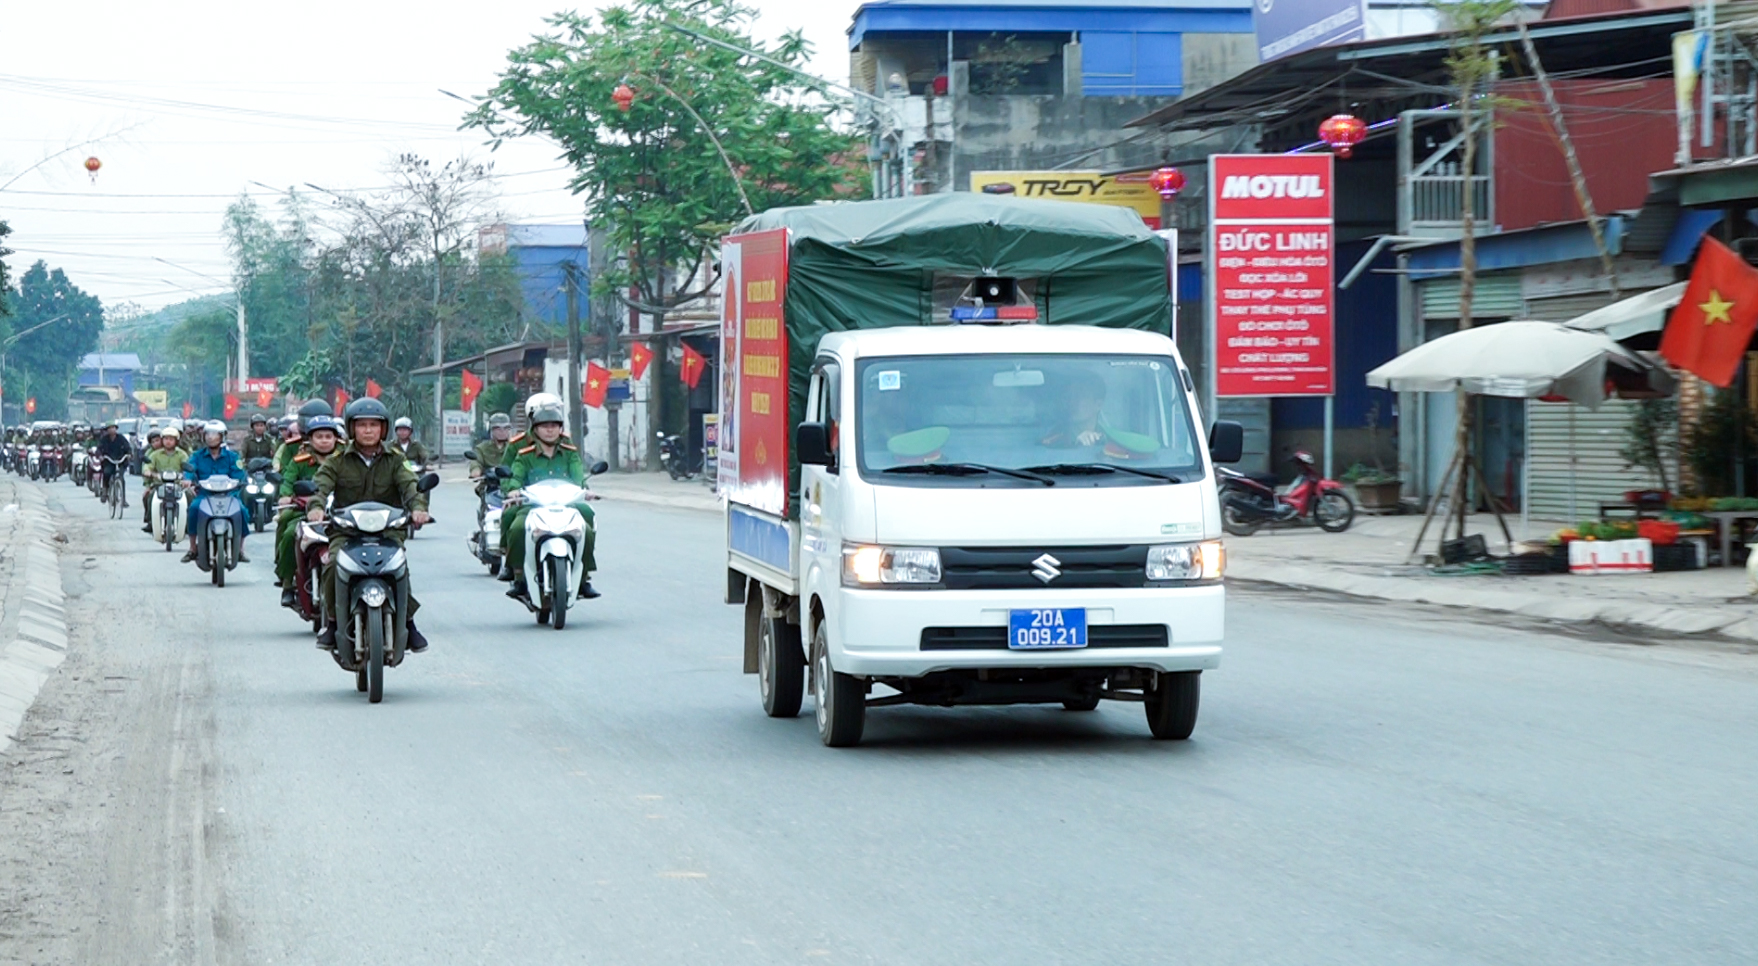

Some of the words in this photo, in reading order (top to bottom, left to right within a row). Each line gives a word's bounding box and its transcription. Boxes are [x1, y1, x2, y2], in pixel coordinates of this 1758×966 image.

[1023, 180, 1106, 196] TROY
[1221, 175, 1325, 199] MOTUL
[1218, 228, 1271, 251] ĐỨC
[1275, 233, 1328, 251] LINH
[1031, 610, 1064, 626] 20A
[1017, 628, 1077, 646] 009.21
